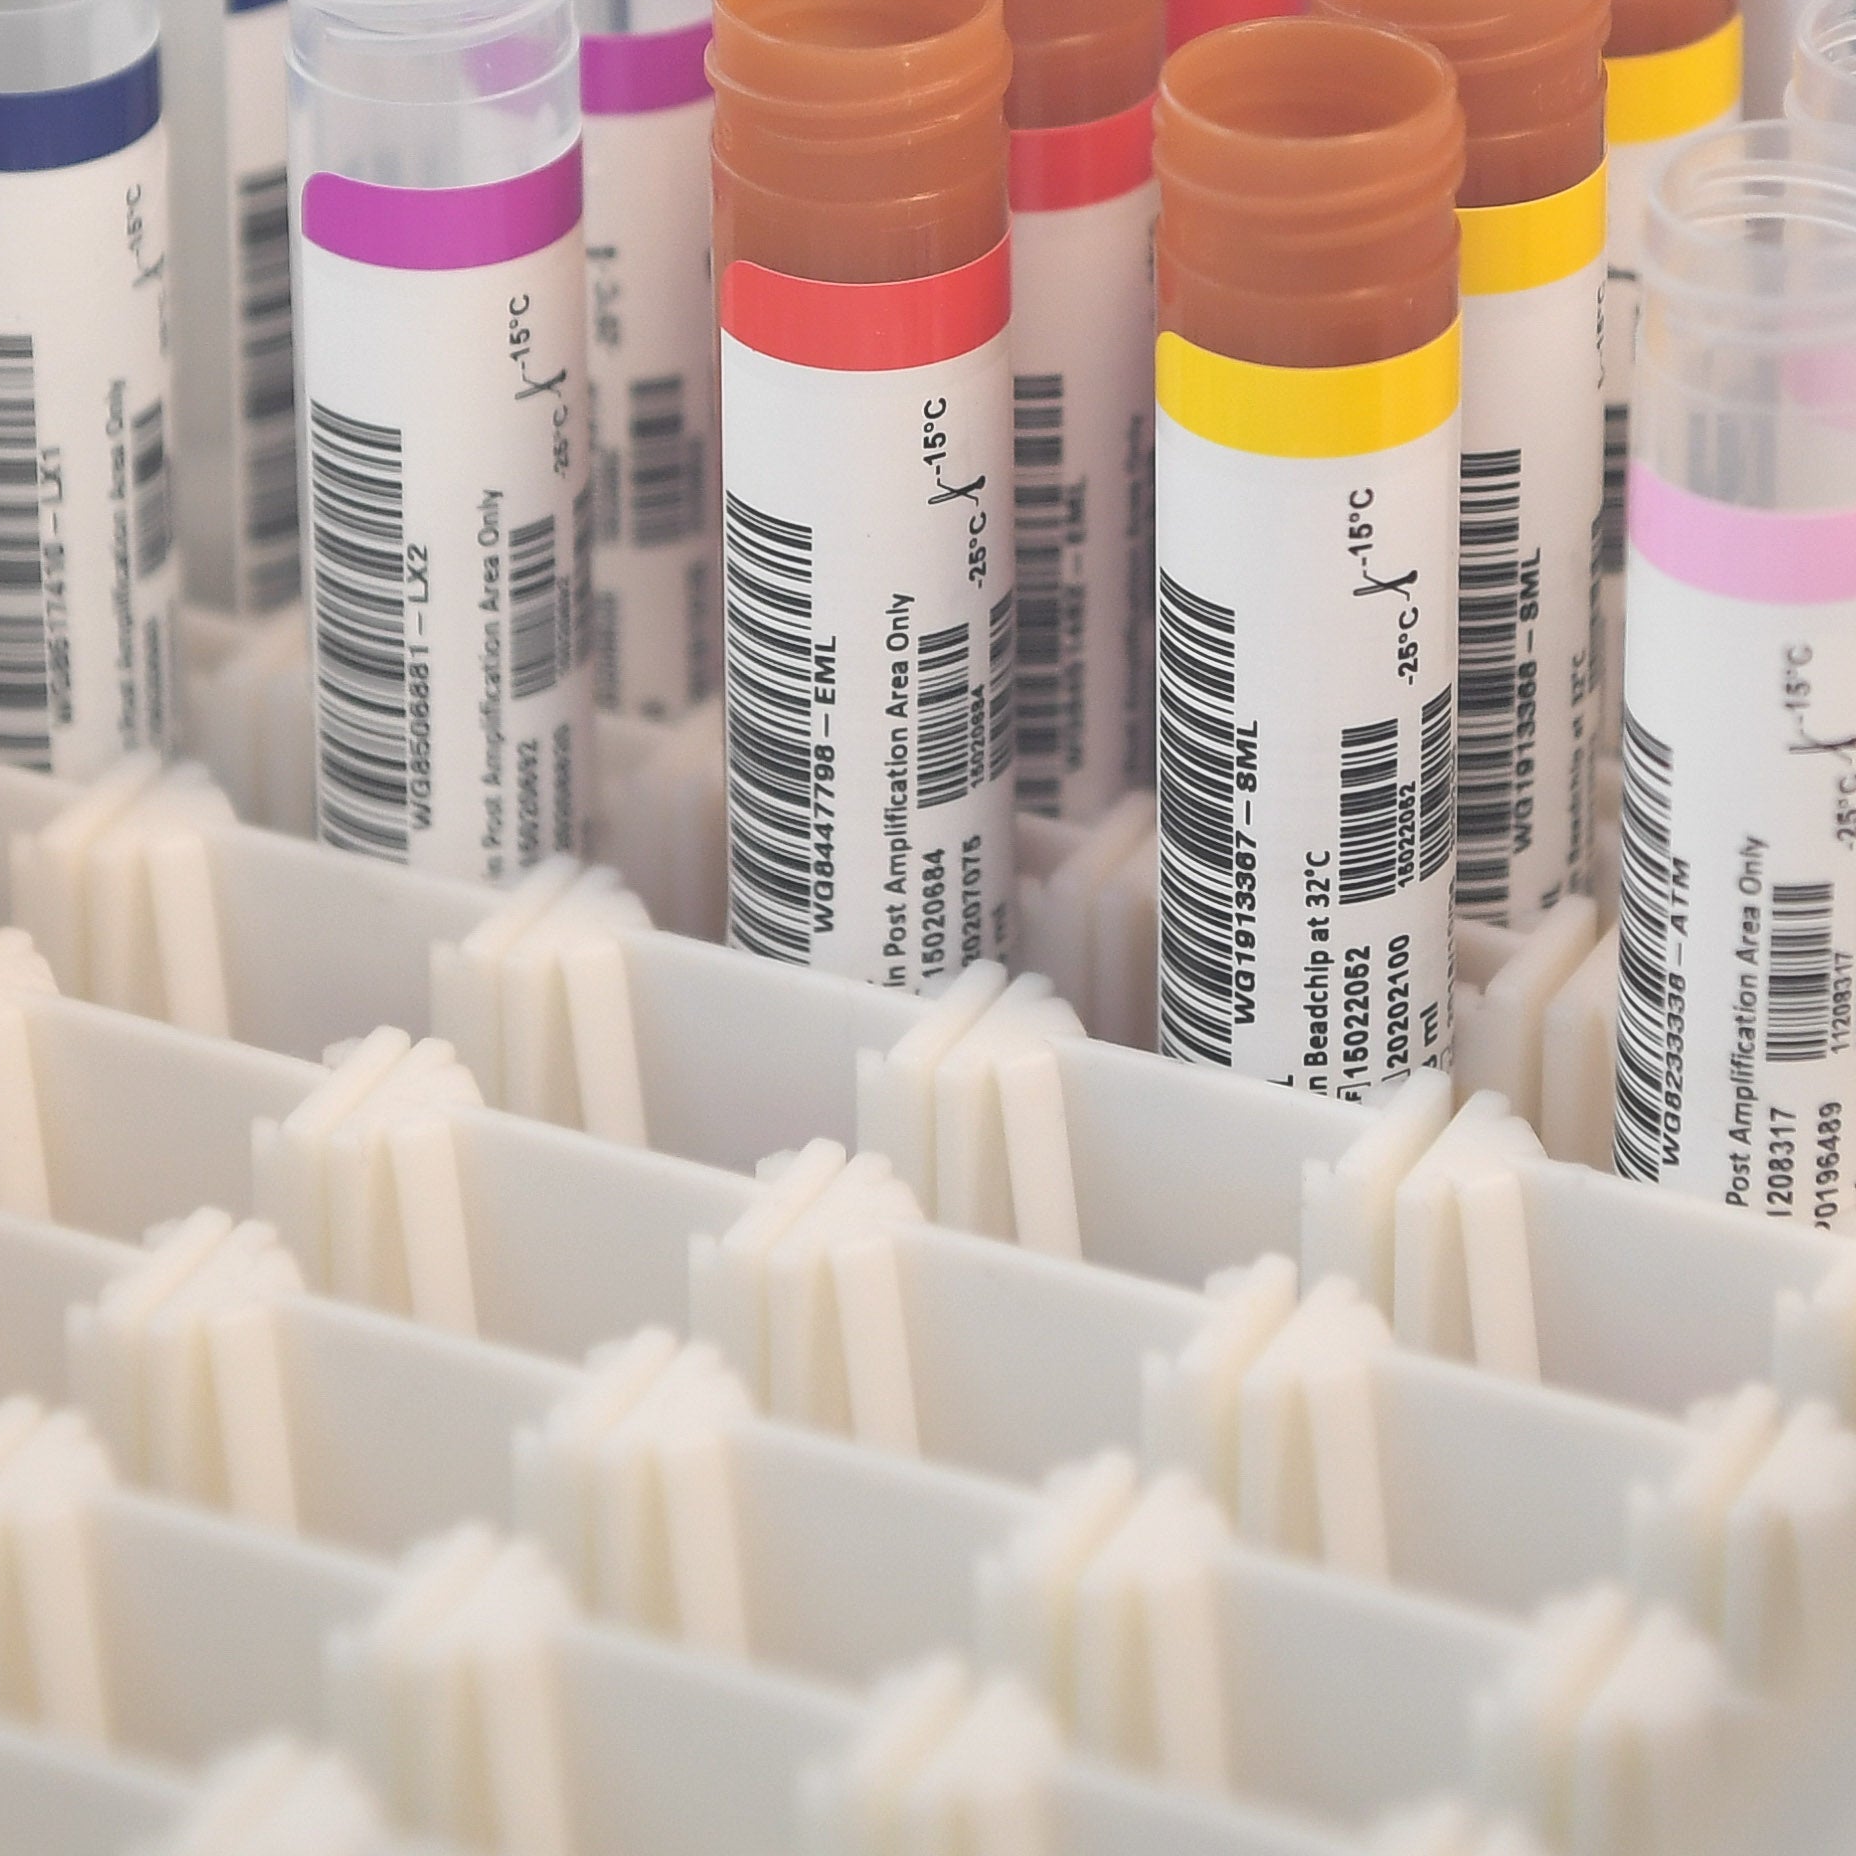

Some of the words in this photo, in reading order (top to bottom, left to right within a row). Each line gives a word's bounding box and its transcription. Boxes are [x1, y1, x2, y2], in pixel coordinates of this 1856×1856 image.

[477, 489, 504, 547] Only
[968, 510, 988, 590] -25°C
[478, 555, 501, 613] Area
[885, 593, 916, 652] Only
[1397, 605, 1420, 686] -25°C
[479, 620, 506, 787] Amplification
[884, 660, 909, 718] Area
[883, 726, 913, 895] Amplification
[1397, 779, 1416, 889] 15022052
[1303, 849, 1331, 909] 32°C
[1738, 834, 1770, 896] Only
[883, 902, 908, 958] Post
[921, 847, 946, 979] 15020684
[1306, 916, 1331, 943] at
[1735, 905, 1761, 967] Area
[1303, 948, 1335, 1067] Beadchip
[1342, 945, 1372, 1079] 15022052
[1386, 933, 1411, 1070] 20202100
[1830, 950, 1855, 1055] 11208317
[1727, 971, 1759, 1147] Amplification
[1725, 1149, 1753, 1208] Post
